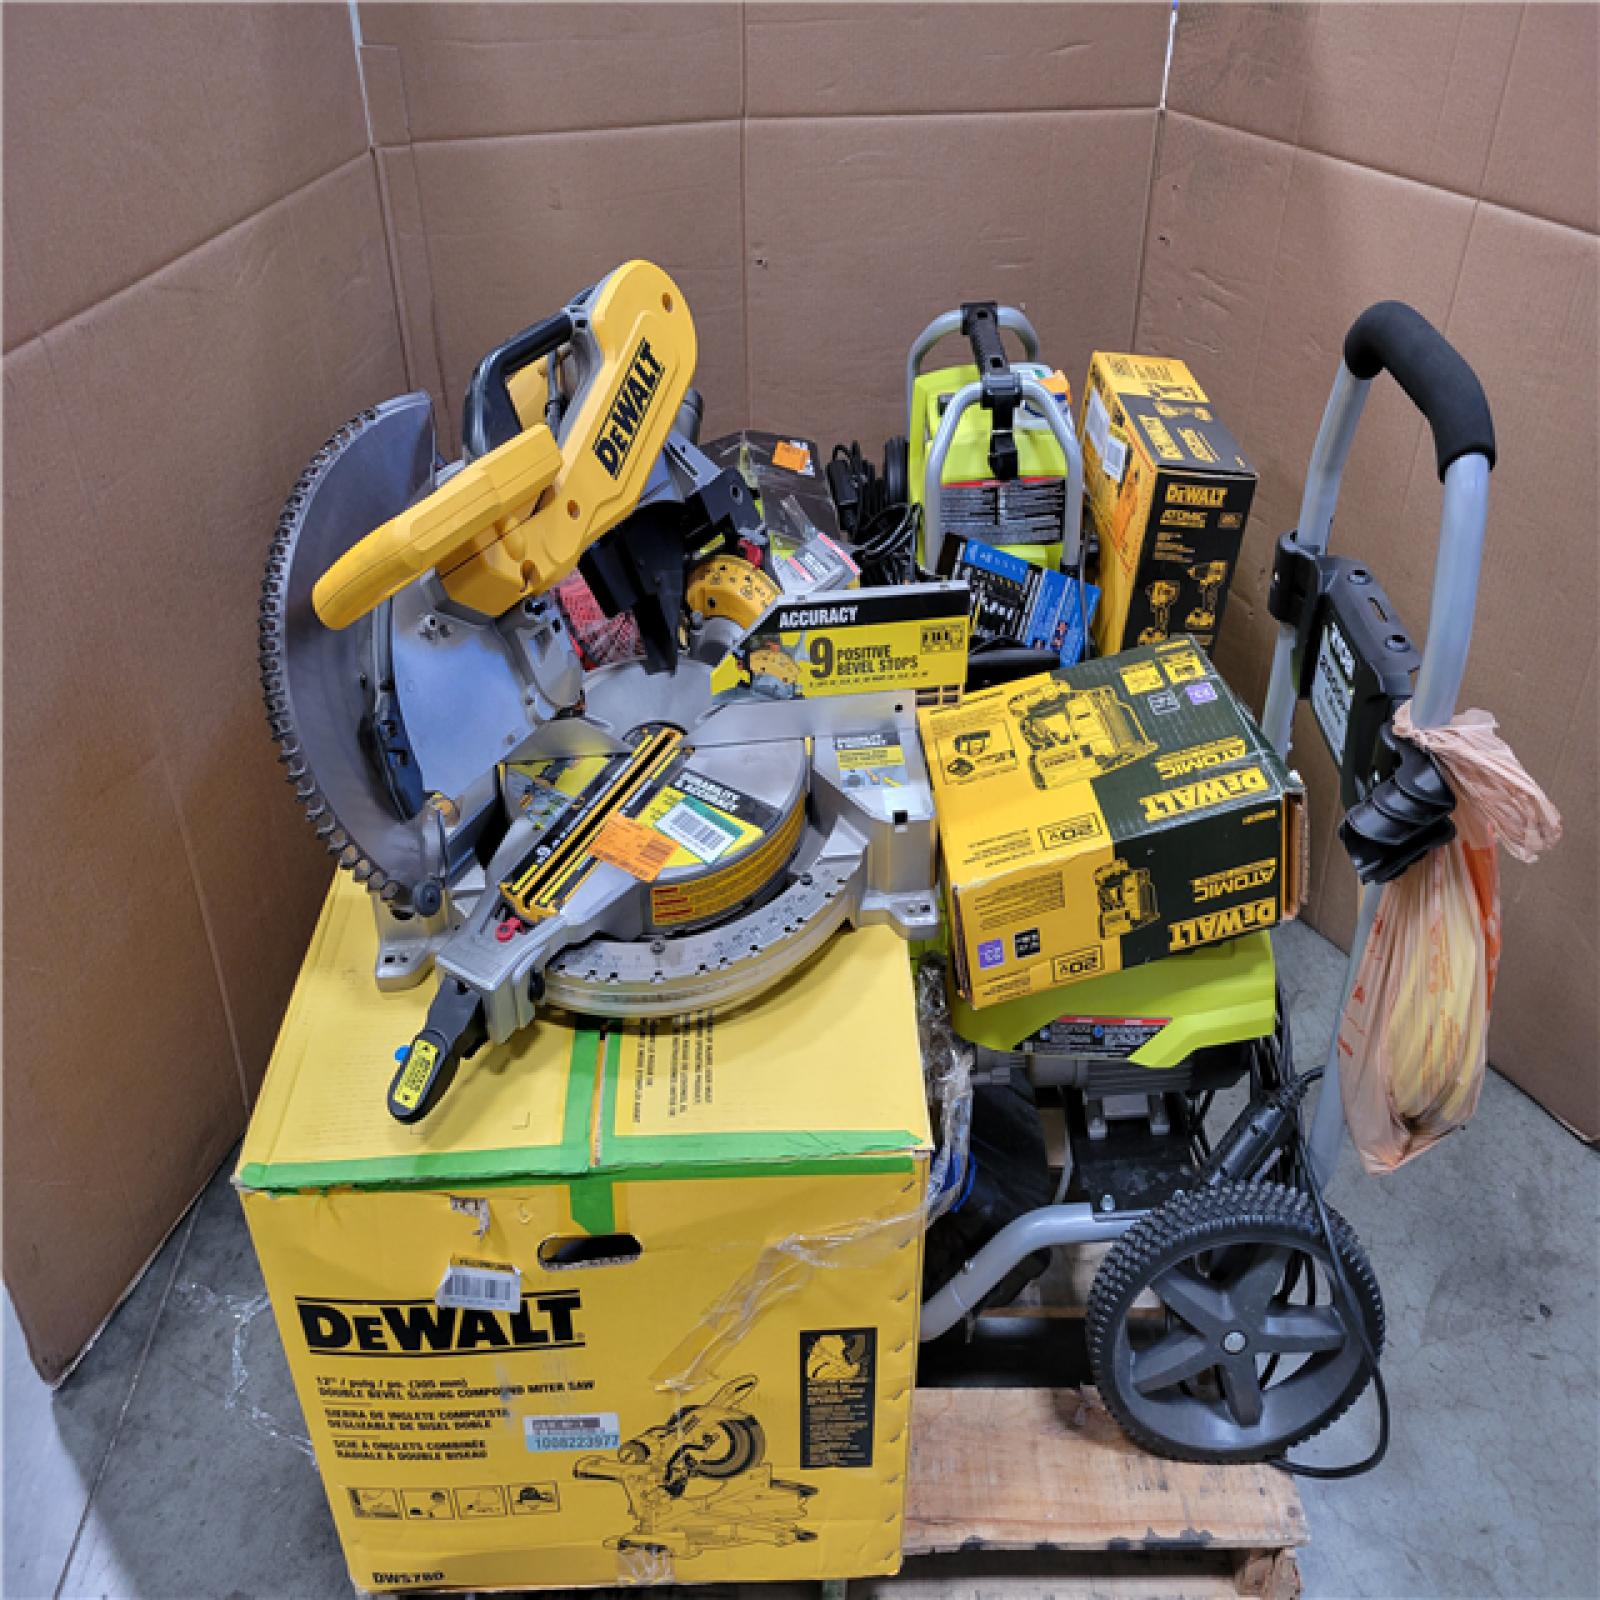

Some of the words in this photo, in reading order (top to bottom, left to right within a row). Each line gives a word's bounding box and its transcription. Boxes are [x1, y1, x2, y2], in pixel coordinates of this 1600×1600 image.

[593, 339, 664, 478] DEWALT
[1165, 483, 1228, 508] DEWALT
[779, 605, 858, 628] ACCURACY
[809, 636, 833, 679] 9
[837, 644, 891, 662] POSITIVE
[837, 658, 876, 676] BEVEL
[879, 655, 918, 672] STOPS
[1158, 746, 1245, 779] ATOMIC
[1140, 767, 1269, 822] DEWALT
[1193, 867, 1276, 902] ATOMIC
[1168, 897, 1276, 951] DEWALT
[297, 1298, 581, 1350] DEWALT
[319, 1387, 364, 1398] DOUBLE
[367, 1388, 404, 1400] BEVEL
[407, 1389, 455, 1400] SLIDING
[457, 1385, 524, 1399] COMPOUND
[528, 1381, 565, 1392] MITER
[568, 1380, 595, 1391] SAW
[325, 1408, 364, 1419] SIERRA
[370, 1410, 384, 1420] DE
[388, 1410, 435, 1421] INGLETE
[439, 1408, 511, 1420] COMPUESTA
[400, 1421, 414, 1431] DE
[454, 1419, 491, 1430] DOBLE
